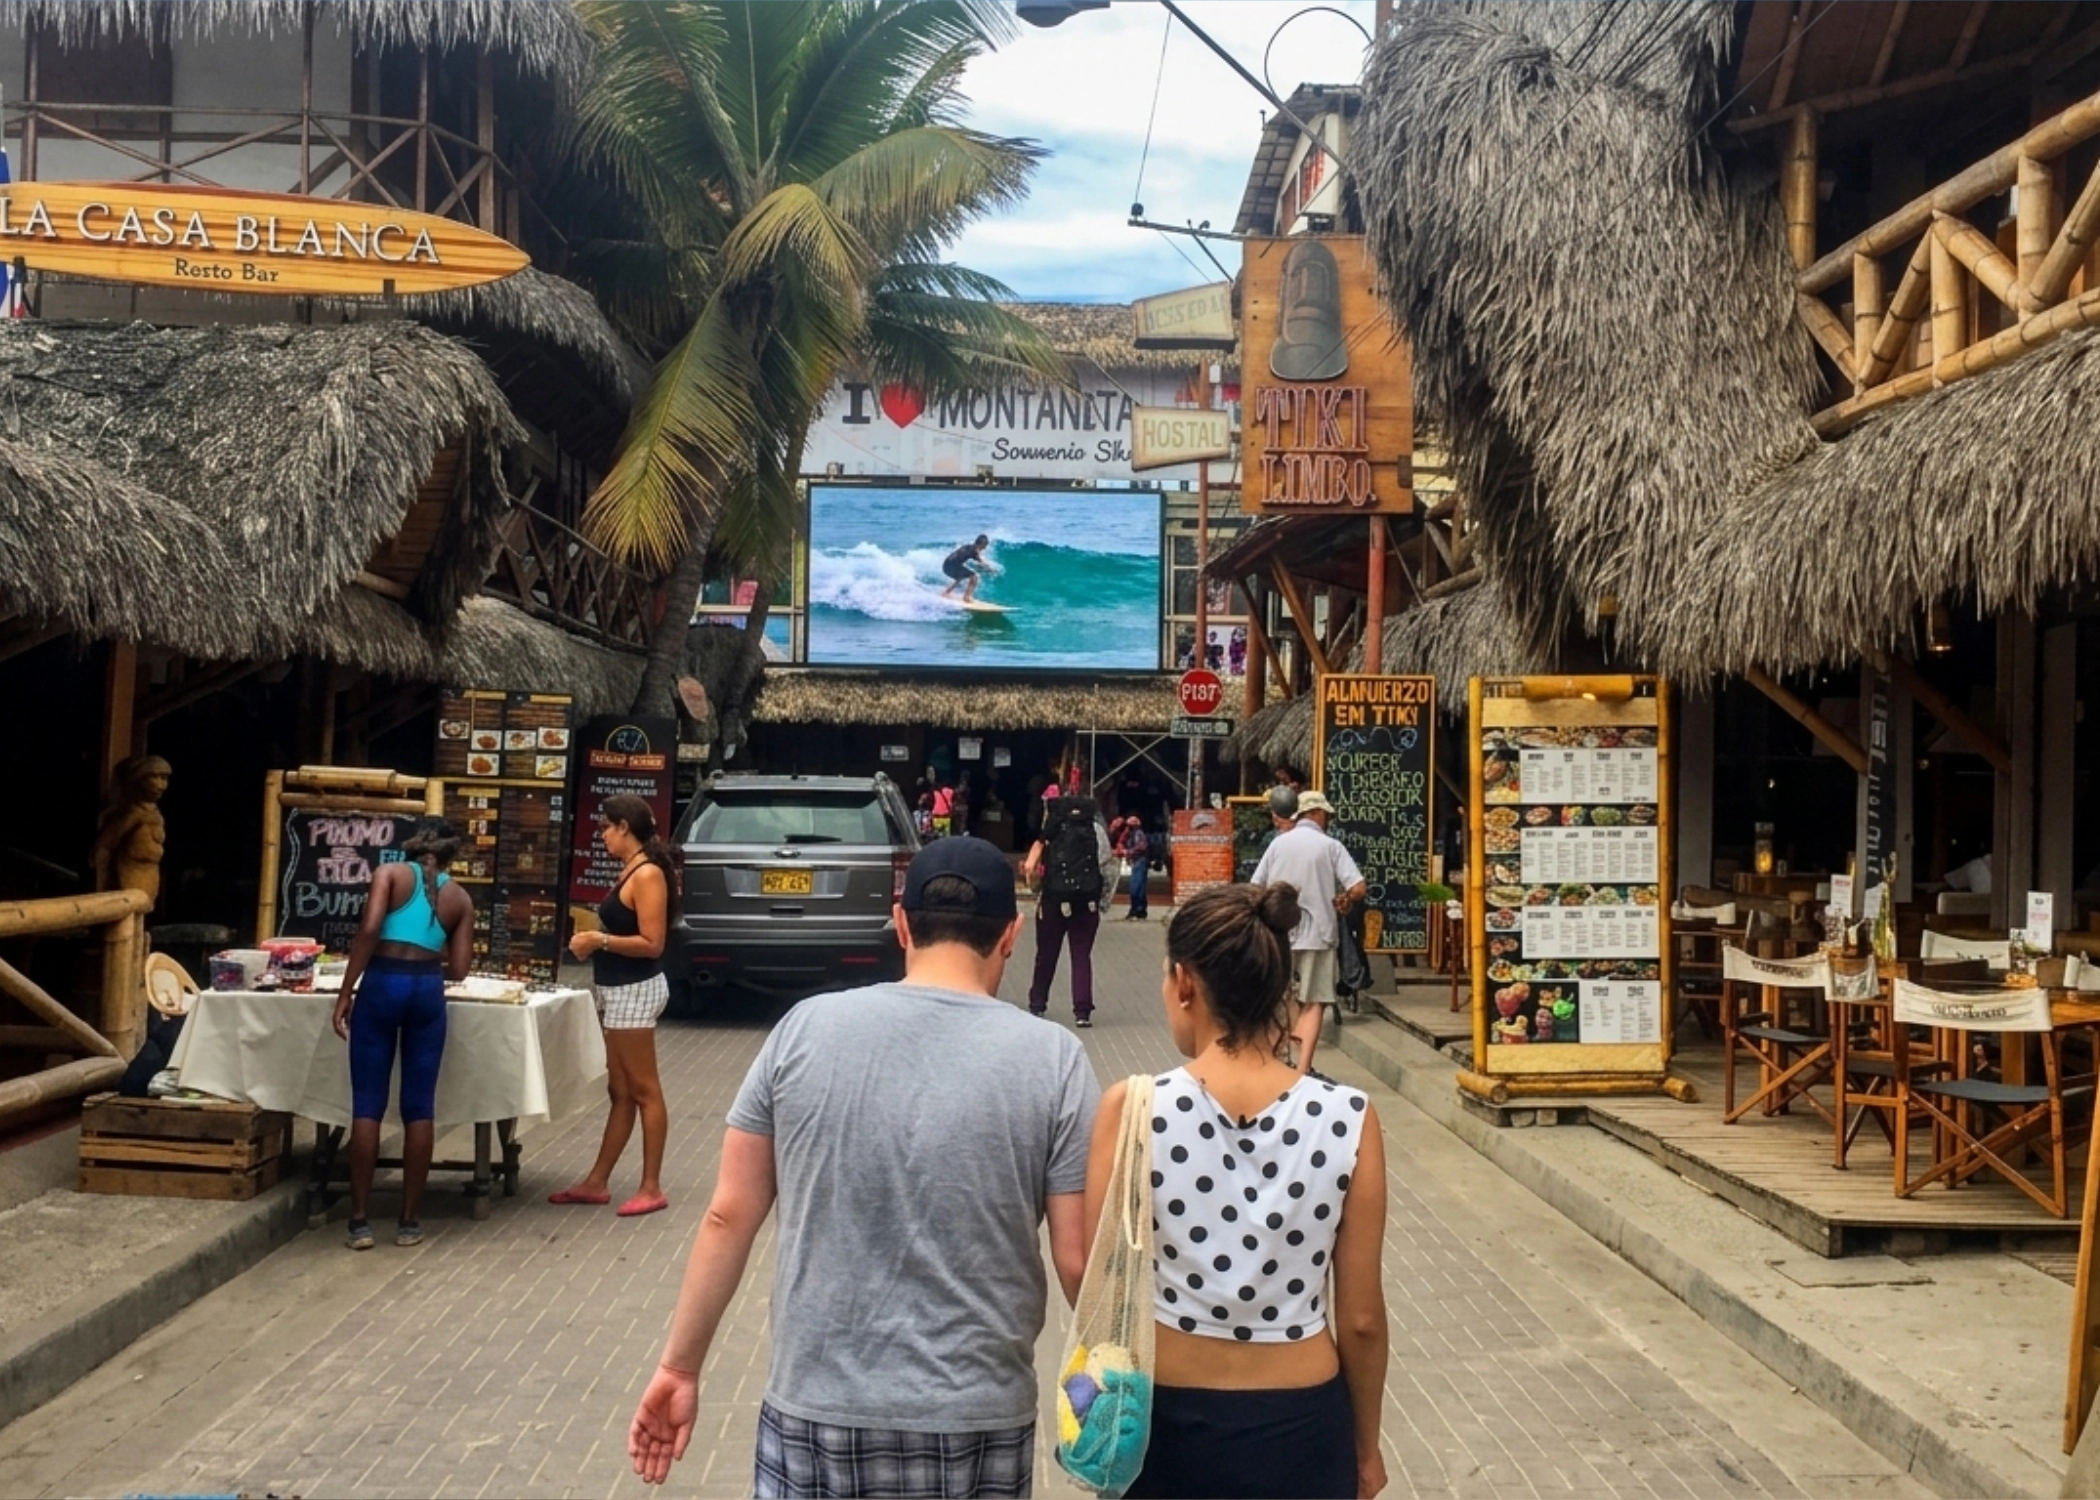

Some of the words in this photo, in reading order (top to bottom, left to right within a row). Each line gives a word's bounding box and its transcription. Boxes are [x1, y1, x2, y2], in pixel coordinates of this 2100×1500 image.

[0, 196, 57, 237] LA
[77, 202, 212, 248] CASA
[235, 215, 440, 264] BLANCA
[174, 257, 233, 280] Resto
[241, 262, 280, 283] Bar
[842, 382, 871, 424] I
[1256, 386, 1369, 452] TIKI
[1142, 418, 1223, 448] HOSTAL
